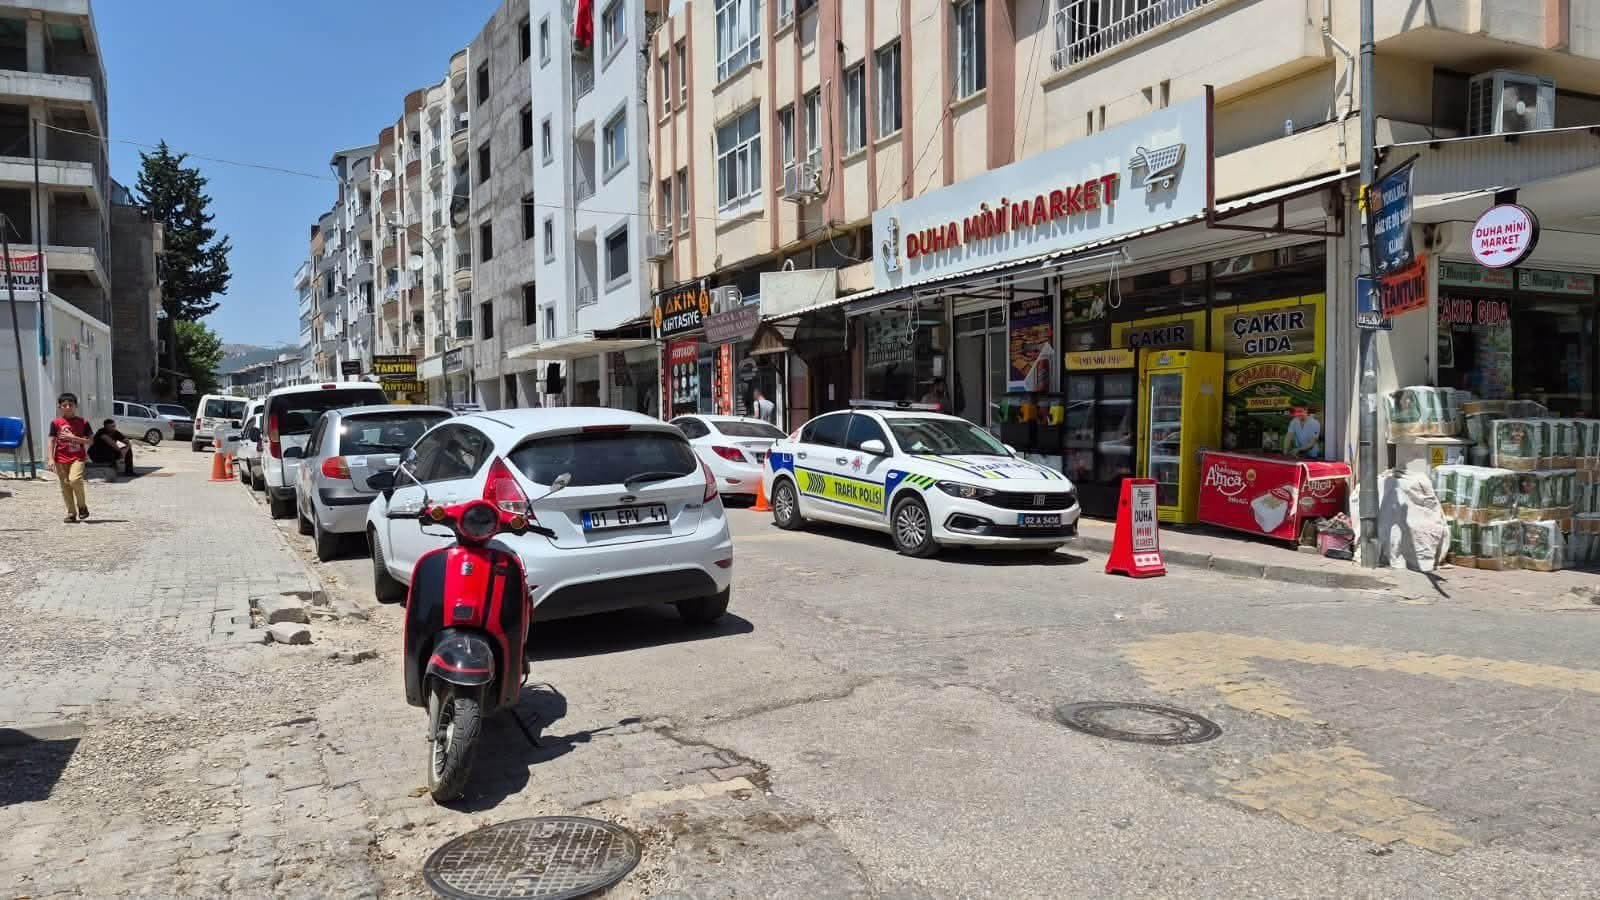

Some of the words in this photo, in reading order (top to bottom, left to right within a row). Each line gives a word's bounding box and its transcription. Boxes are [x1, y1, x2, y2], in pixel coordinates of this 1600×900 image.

[906, 221, 960, 259] DUHA
[963, 197, 1010, 244] MİNİ
[1011, 172, 1120, 231] MARKET
[1476, 225, 1502, 238] DUHA
[1505, 217, 1527, 233] MİNİ
[1481, 233, 1520, 248] MARKET
[665, 288, 696, 313] AKIN
[663, 310, 700, 332] KIRTASİYE
[1477, 300, 1508, 325] GIDA
[1233, 311, 1305, 339] ÇAKIR
[1244, 335, 1292, 354] GIDA
[1204, 466, 1242, 487] Amca
[834, 480, 858, 500] TRAFİK
[591, 512, 607, 527] 01
[617, 508, 640, 525] EPV
[650, 507, 665, 522] 41
[1135, 510, 1153, 522] DUHA
